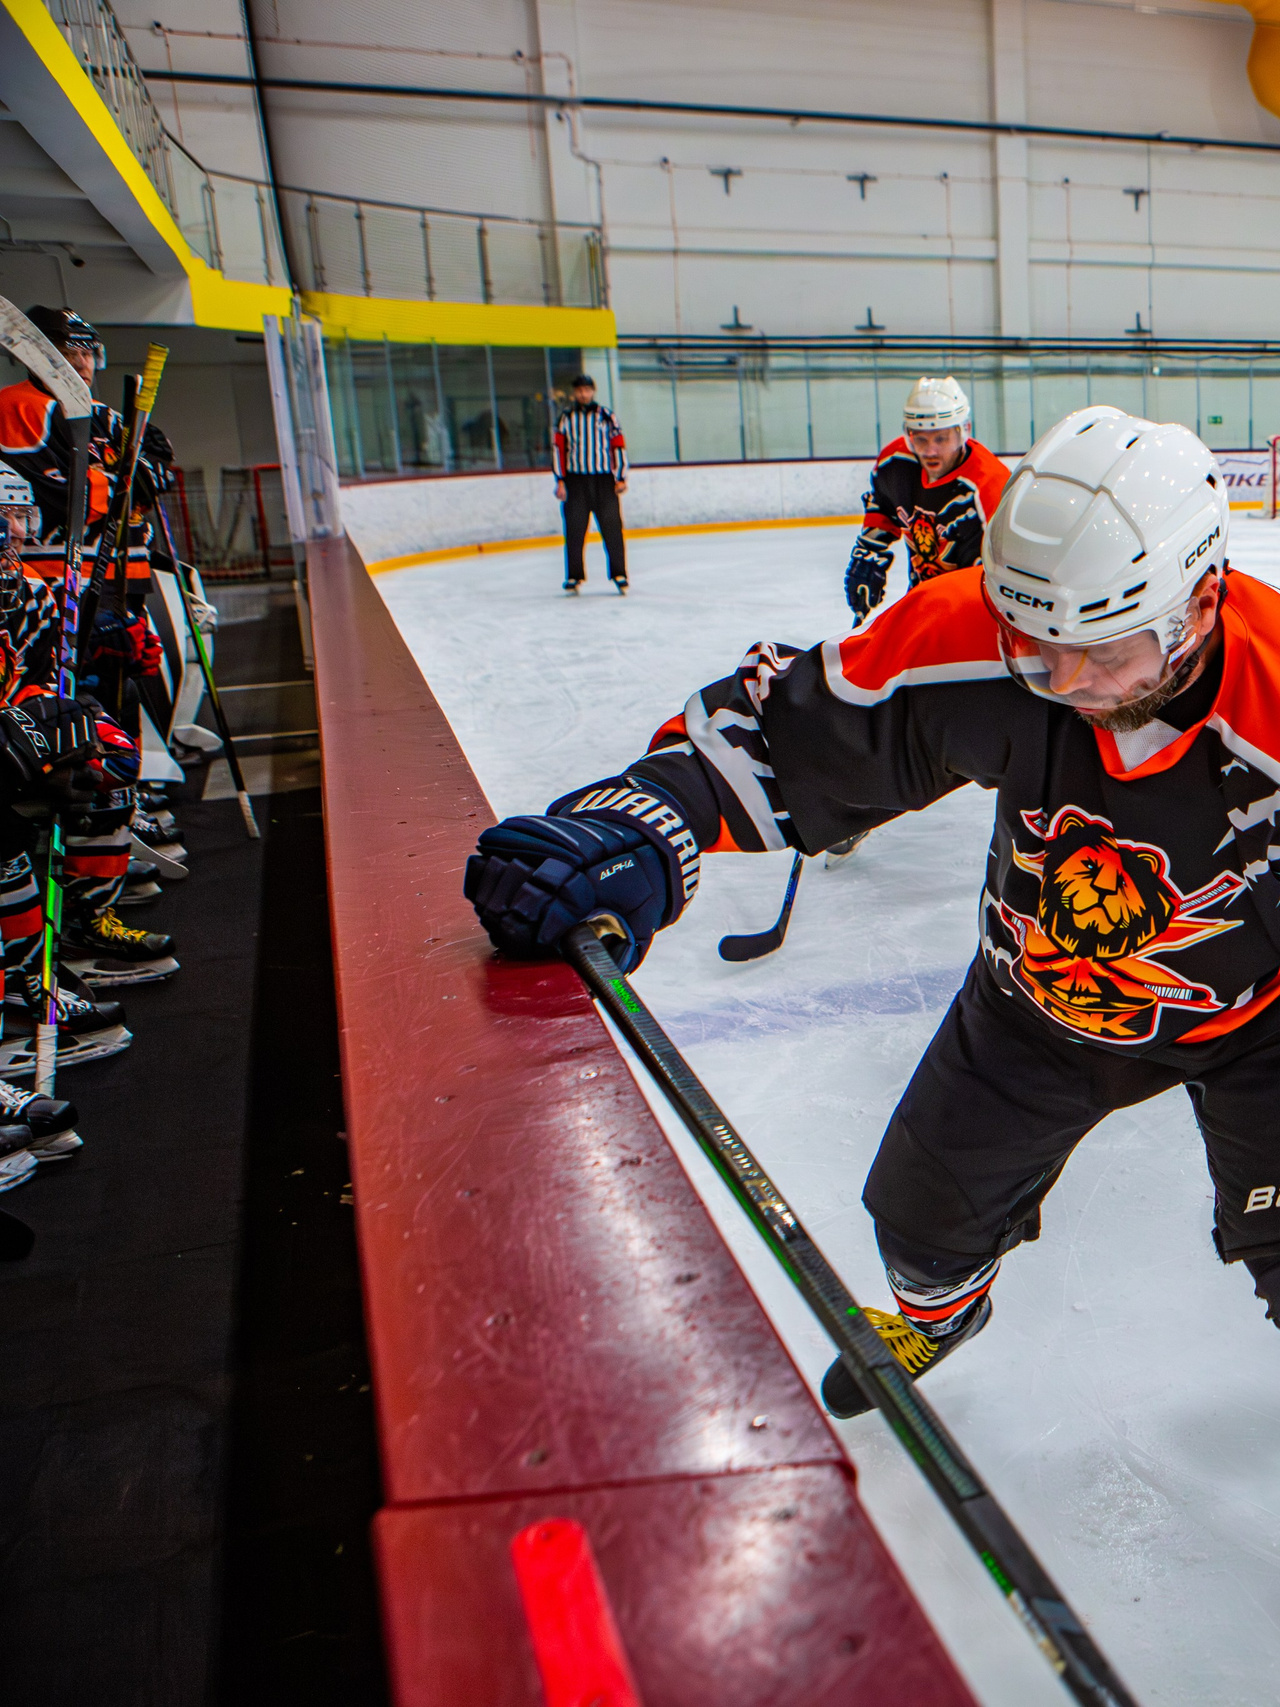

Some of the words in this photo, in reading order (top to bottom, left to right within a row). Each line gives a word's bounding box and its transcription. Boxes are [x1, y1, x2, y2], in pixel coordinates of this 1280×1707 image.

[1184, 525, 1221, 570] CCM
[999, 585, 1055, 612] CCM
[571, 787, 701, 909] WARRIO
[599, 859, 635, 881] ALPHA
